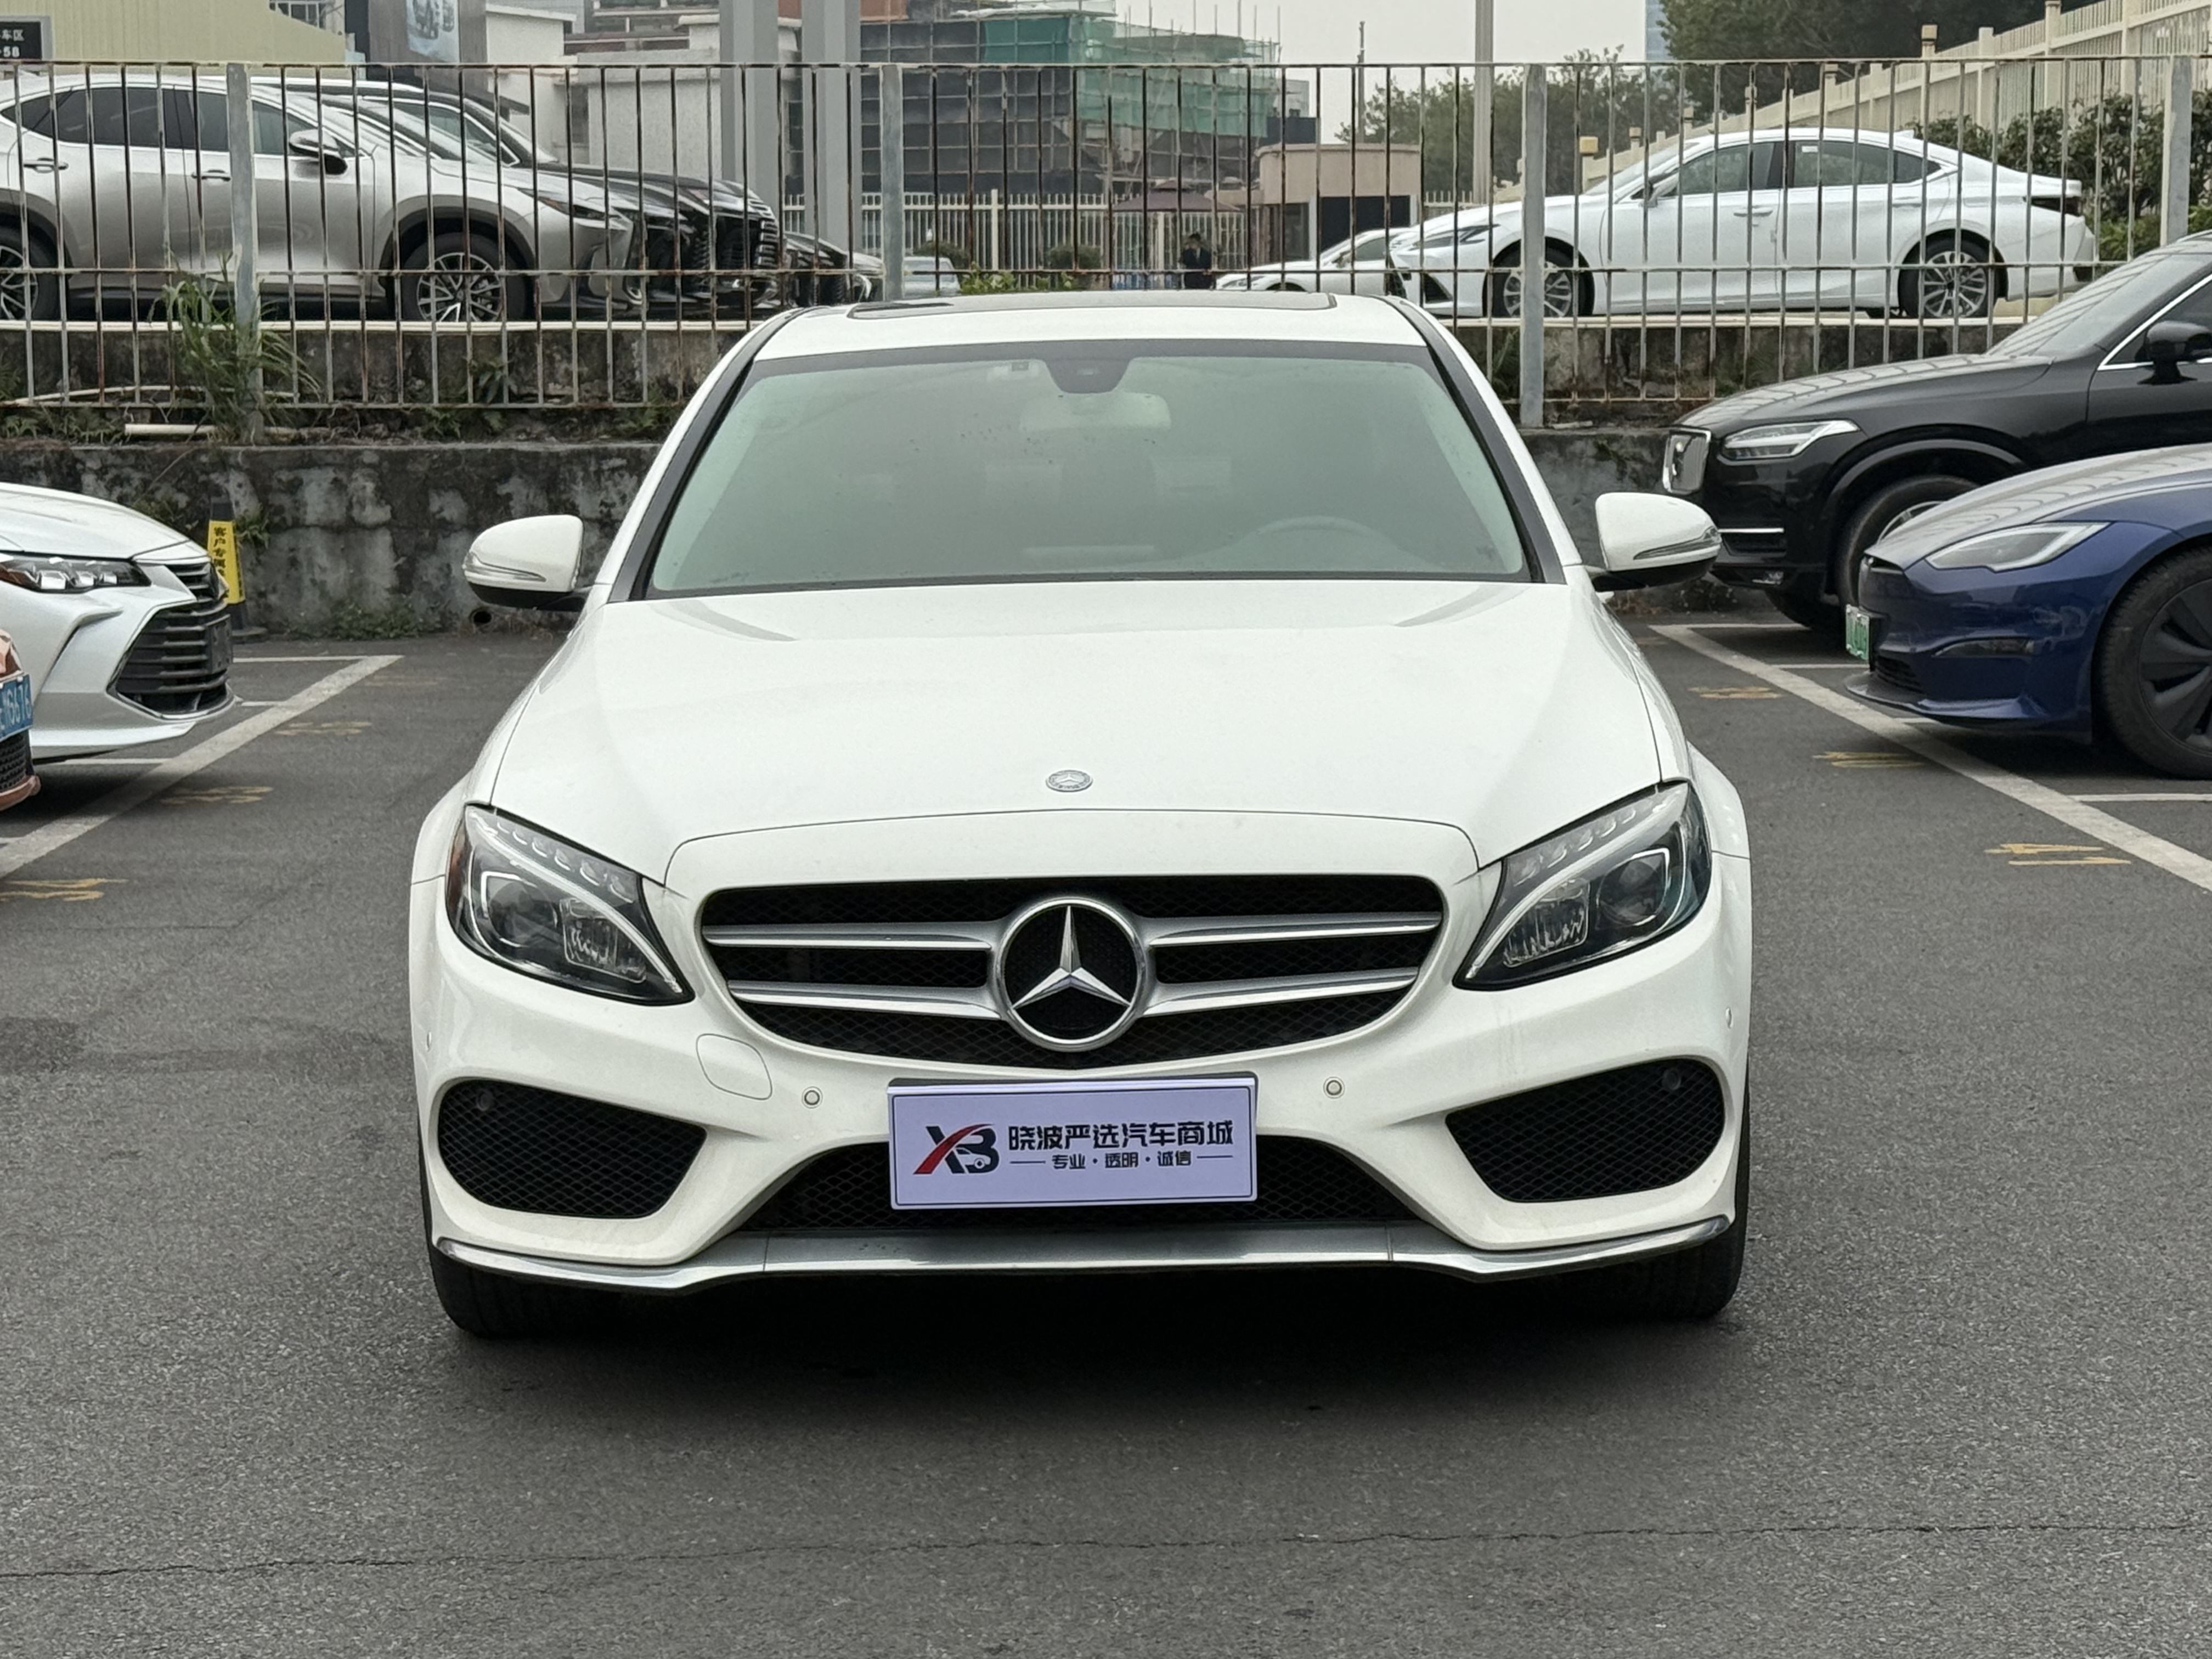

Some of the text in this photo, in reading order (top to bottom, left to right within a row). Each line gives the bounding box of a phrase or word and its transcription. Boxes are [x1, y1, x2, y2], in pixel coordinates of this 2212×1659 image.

[0, 29, 24, 41] 车区
[1008, 1120, 1233, 1150] 晓波严选汽车商城
